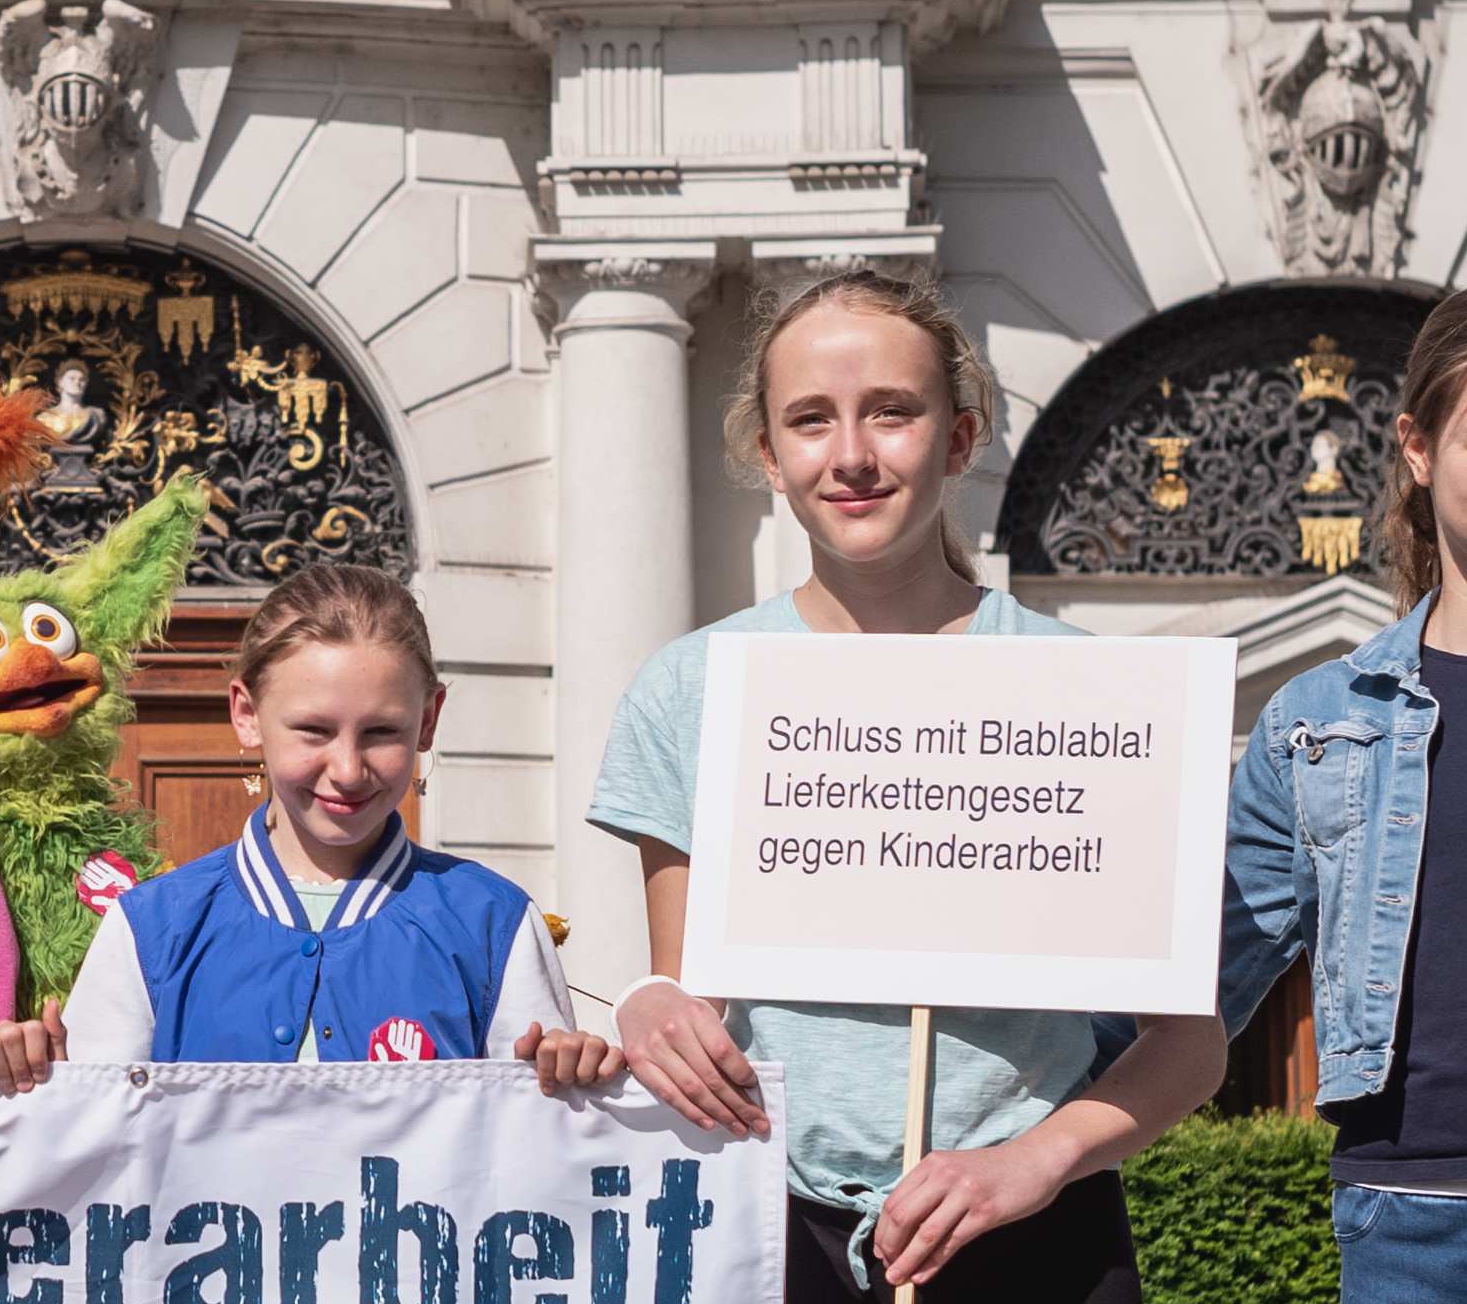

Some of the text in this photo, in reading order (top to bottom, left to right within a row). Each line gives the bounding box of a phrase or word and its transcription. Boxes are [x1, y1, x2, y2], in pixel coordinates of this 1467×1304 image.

[767, 715, 1152, 759] Schluss mit Blablabla!
[763, 771, 1085, 823] Lieferkettengesetz
[758, 831, 1103, 875] gegen Kinderarbeit!
